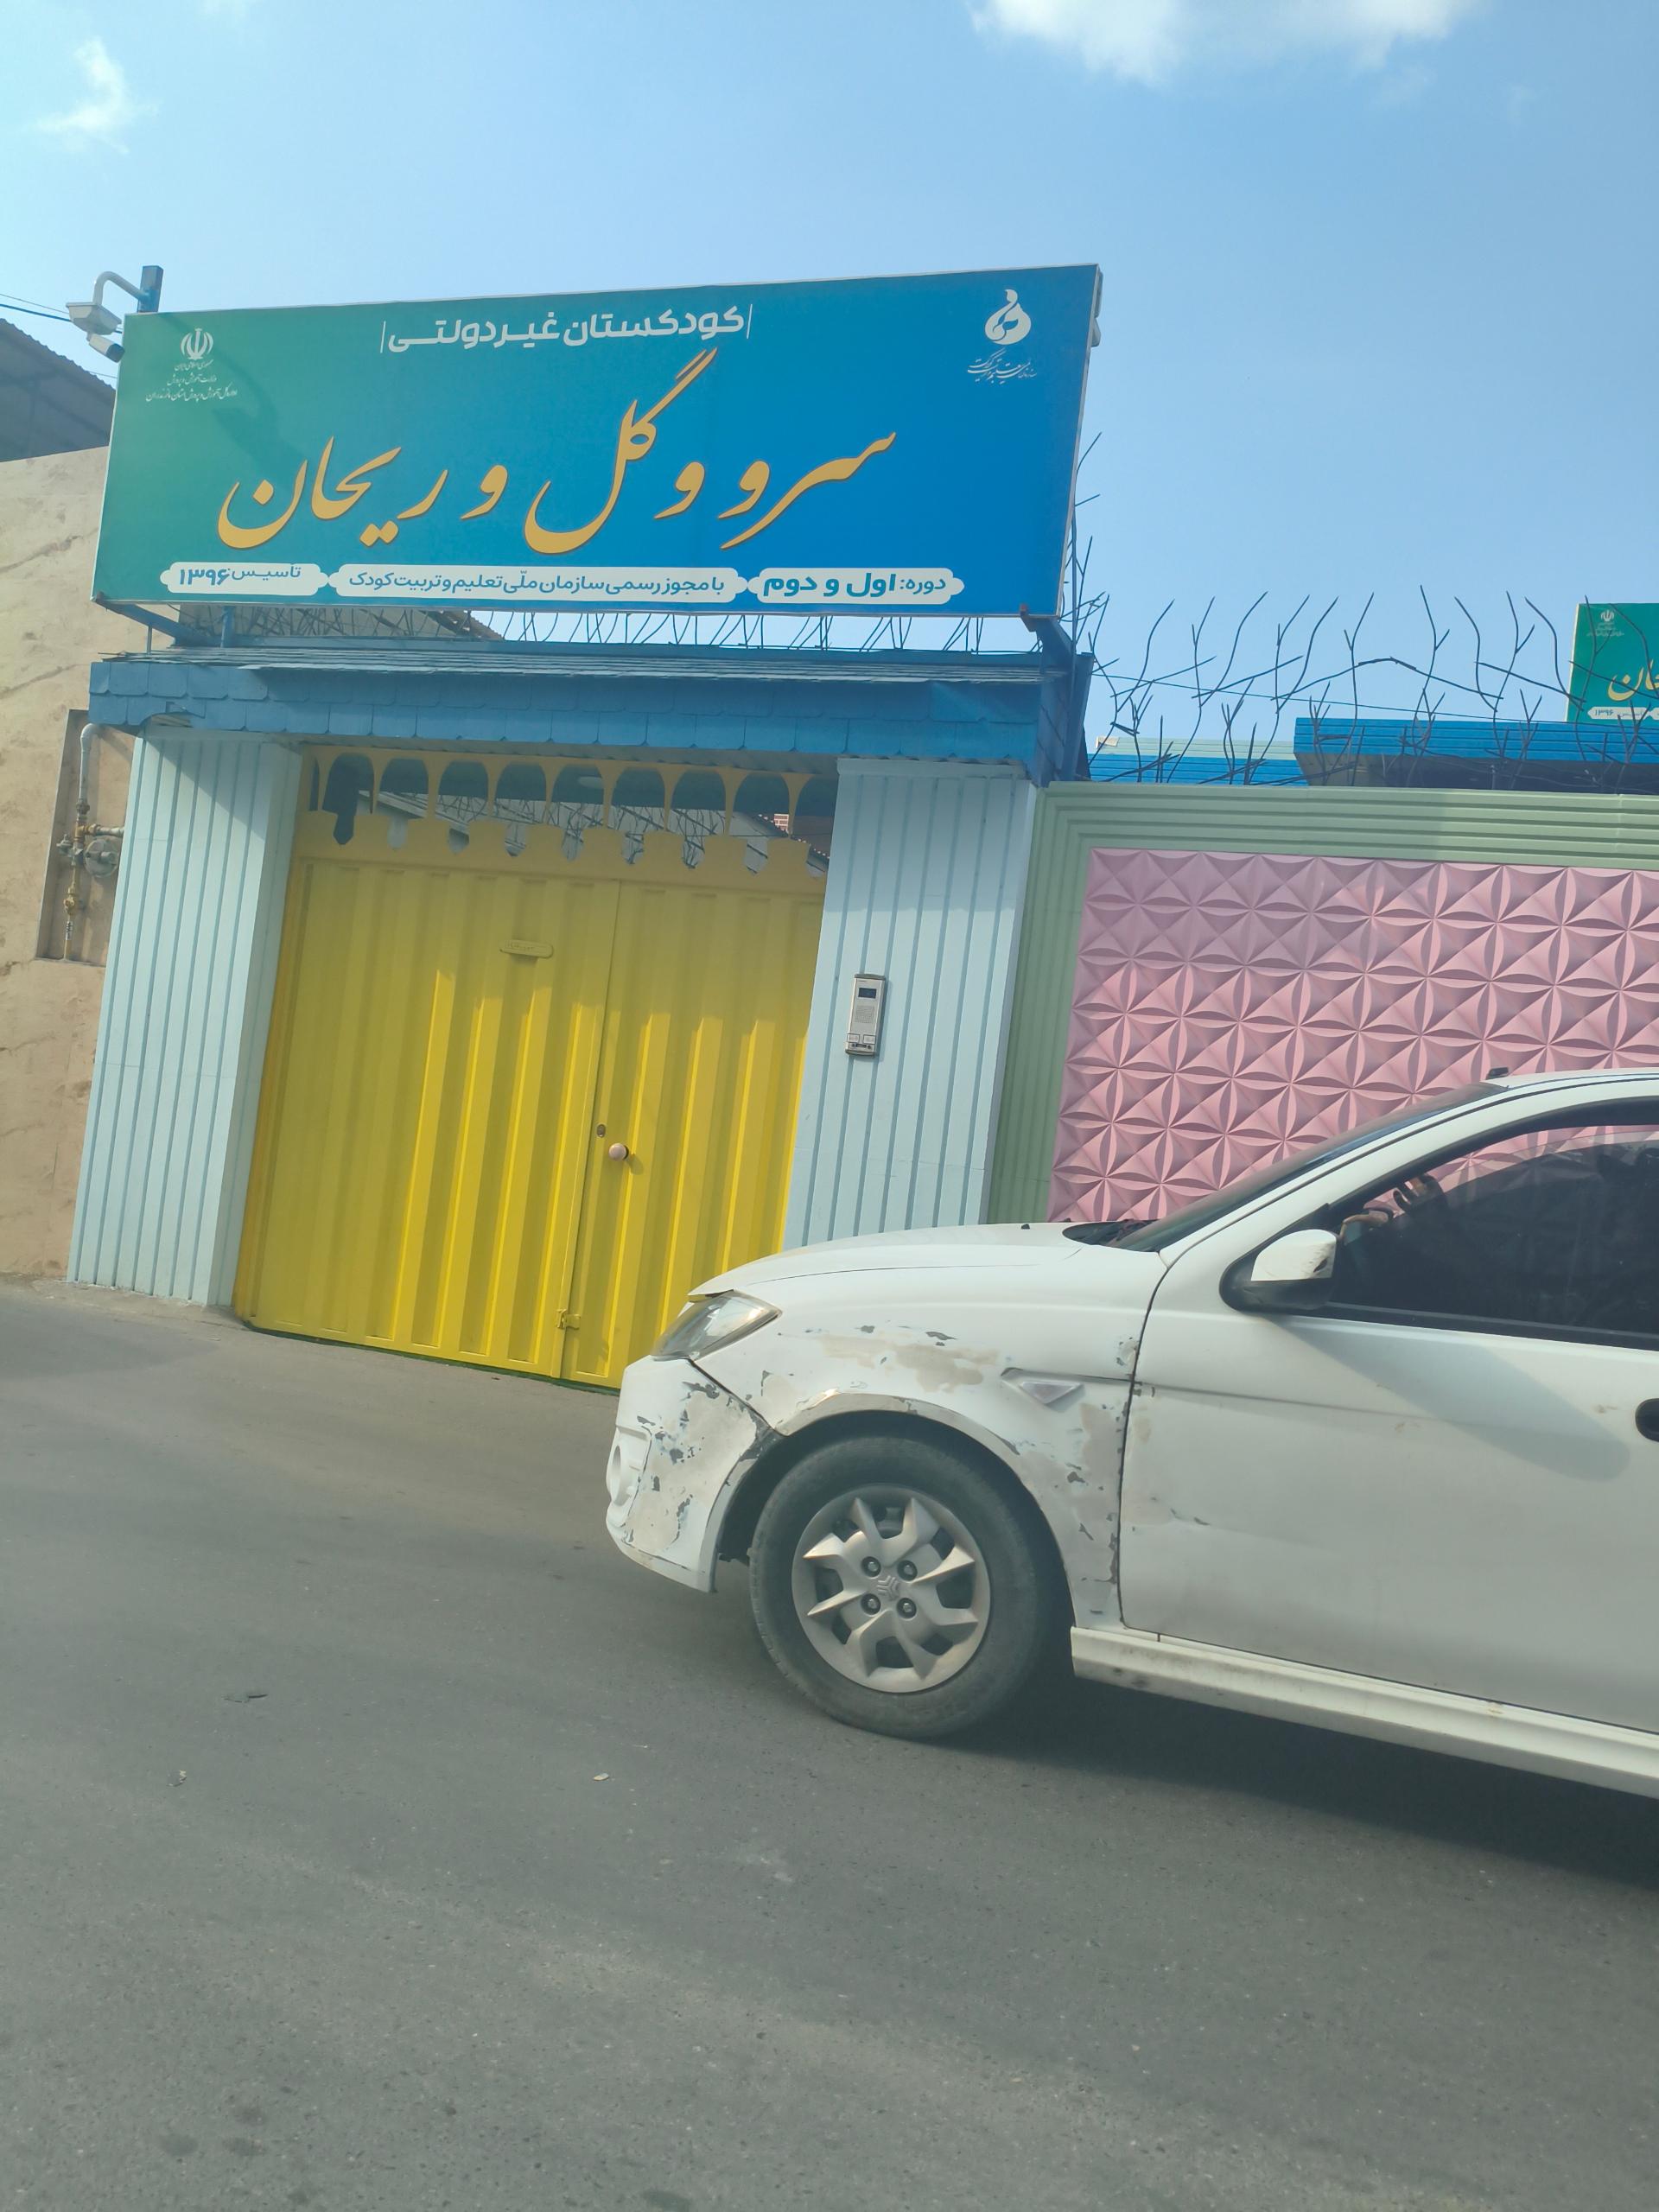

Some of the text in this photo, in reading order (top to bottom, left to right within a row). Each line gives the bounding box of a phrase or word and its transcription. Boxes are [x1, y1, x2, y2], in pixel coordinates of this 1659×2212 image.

[389, 304, 745, 353] کودکستان غیردولتی
[217, 346, 896, 555] سرو و گل و ریحان
[180, 567, 229, 586] ۱۳۹۶
[349, 572, 395, 590] کودک
[393, 575, 442, 591] تربیت
[442, 578, 452, 592] و
[451, 574, 503, 594] تعلیم
[538, 575, 605, 594] سازمان
[711, 576, 725, 594] با
[763, 572, 946, 598] دوره: اول و دوم
[605, 579, 663, 595] رسمی
[661, 578, 709, 596] مجوز
